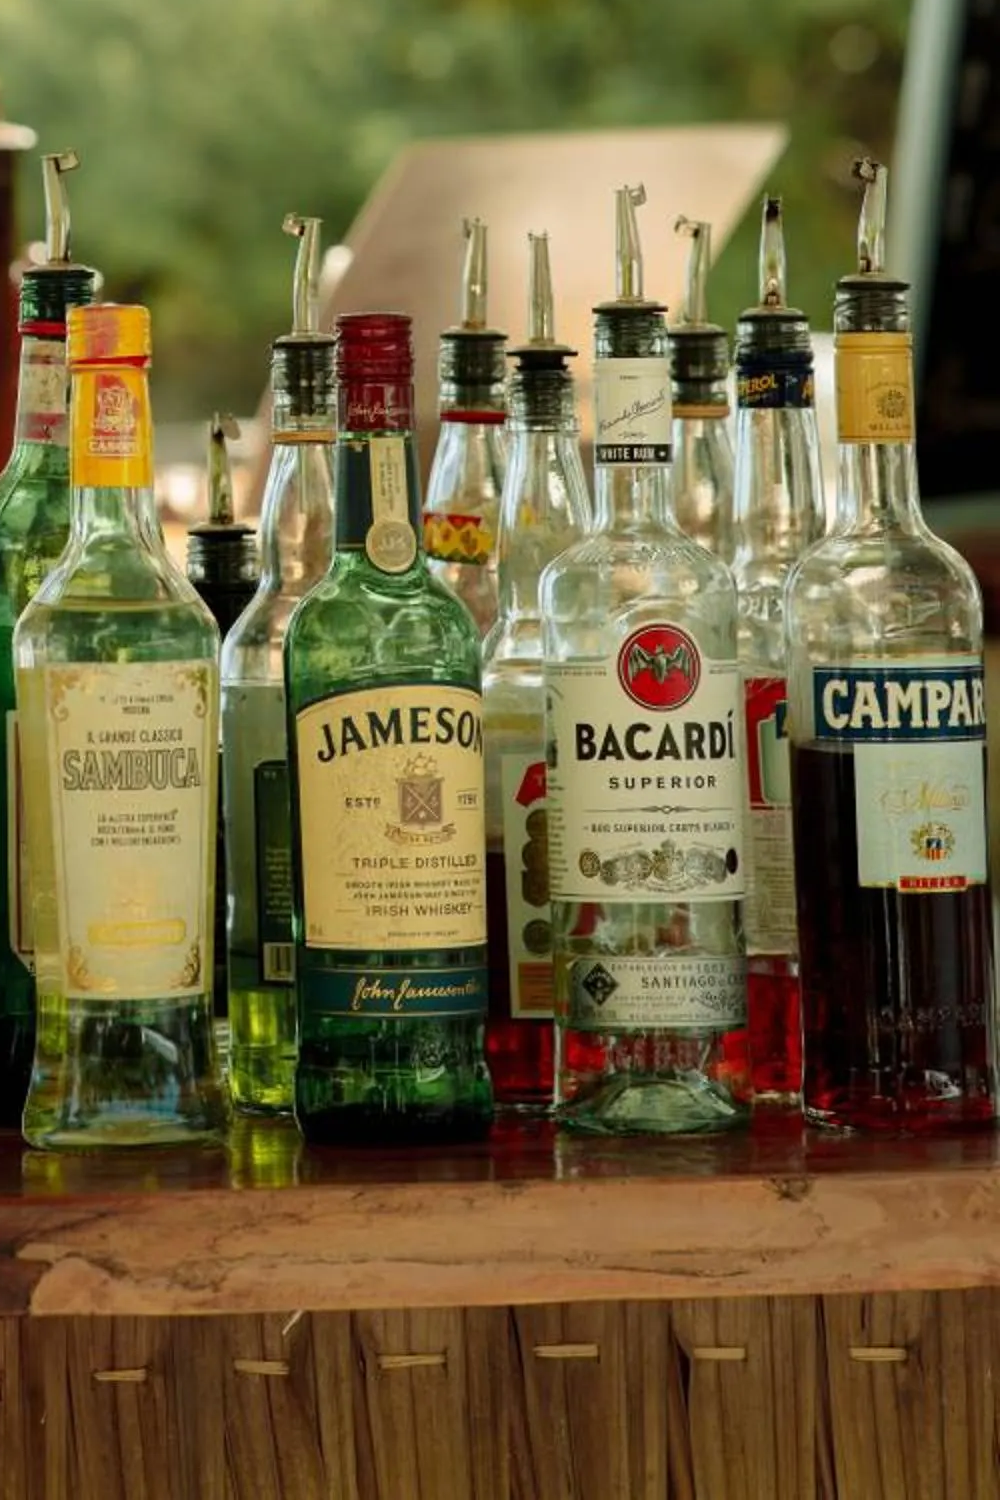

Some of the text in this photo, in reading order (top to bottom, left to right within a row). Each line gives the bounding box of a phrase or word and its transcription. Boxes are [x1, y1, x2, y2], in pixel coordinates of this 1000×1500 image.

[575, 709, 735, 762] BACARDÍ
[63, 747, 201, 791] SAMBUCA
[608, 774, 717, 791] SUPERIOR
[351, 853, 478, 870] TRIPLE DISTILLED
[365, 901, 472, 917] IRISH WHISKEY
[641, 974, 717, 989] SANTIAGO
